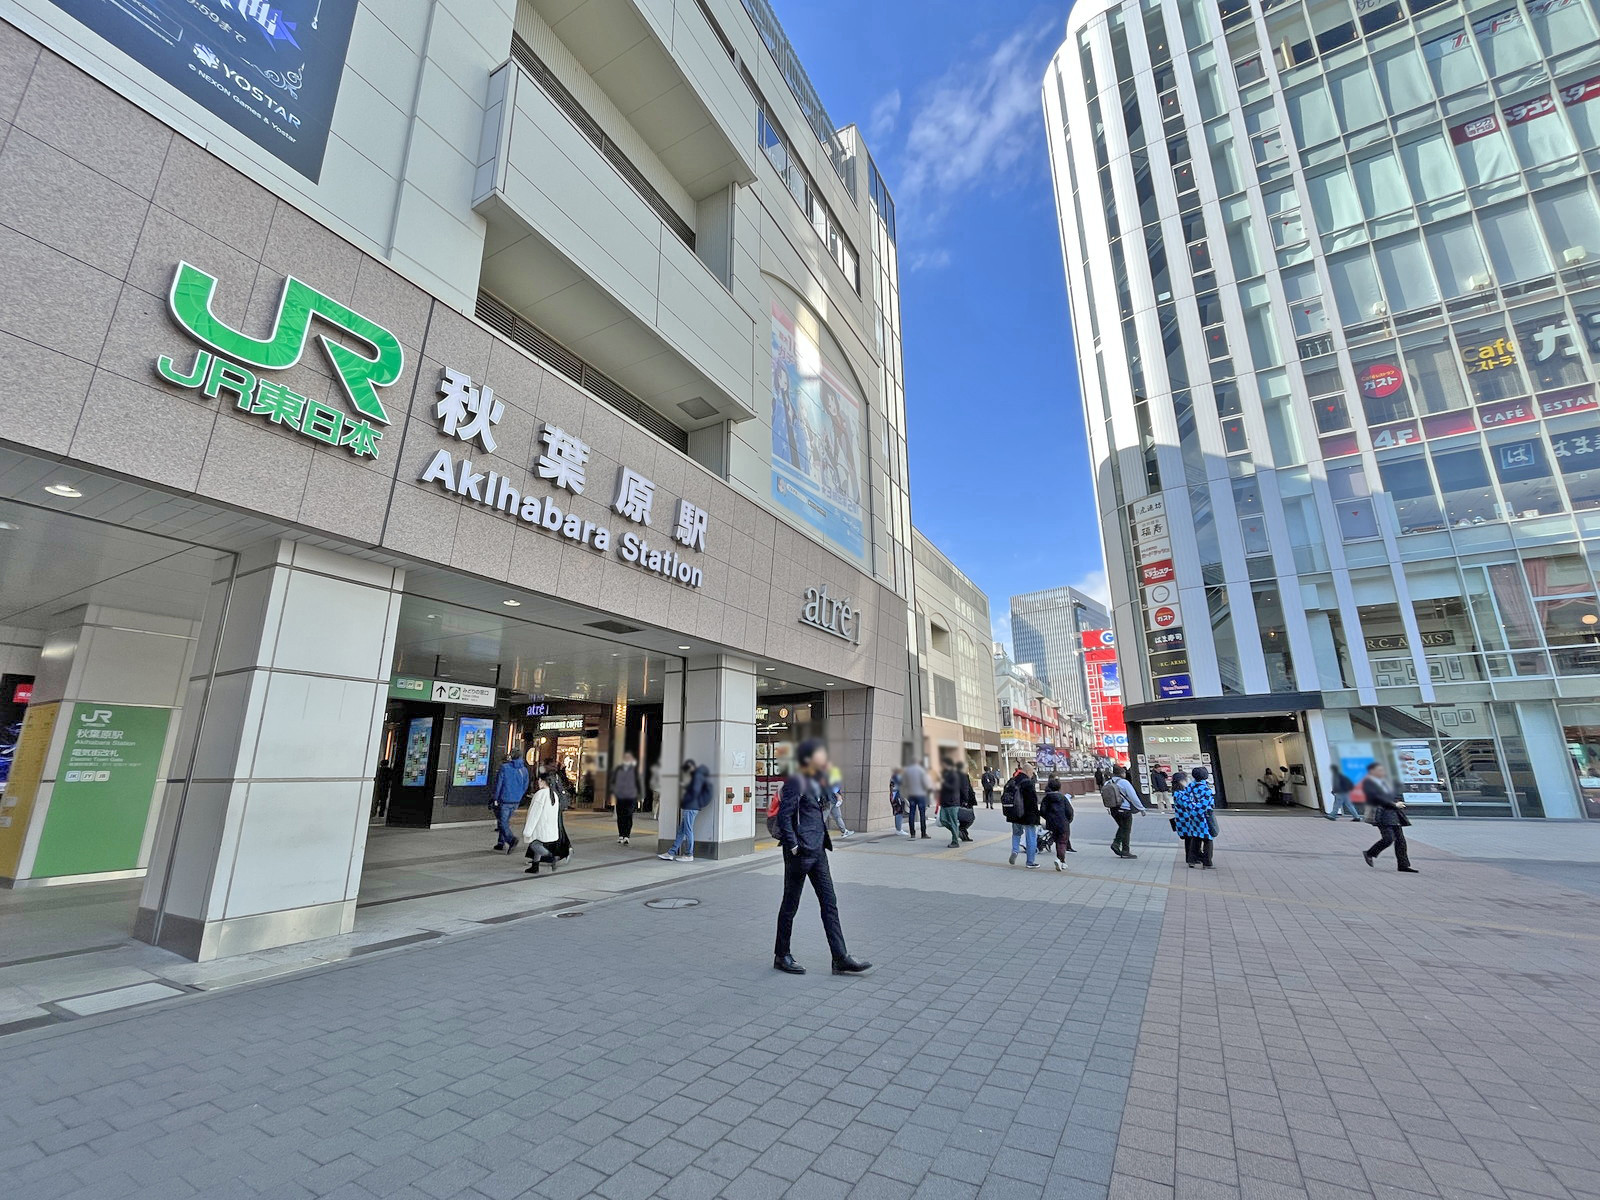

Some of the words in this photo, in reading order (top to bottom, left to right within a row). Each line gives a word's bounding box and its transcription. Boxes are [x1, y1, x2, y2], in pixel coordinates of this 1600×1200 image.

[187, 0, 247, 43] :59まで
[222, 62, 301, 129] YOSTAR
[198, 69, 231, 97] NEXON
[232, 94, 262, 119] Games
[271, 121, 297, 143] Yostar
[167, 260, 403, 425] JR
[1363, 376, 1398, 391] ガスト
[155, 349, 384, 460] JR東日本
[1482, 404, 1525, 423] CAFÉ
[1373, 428, 1414, 448] 4F
[434, 366, 708, 553] 秋葉原駅
[1507, 447, 1529, 463] は
[419, 449, 611, 552] Akihabara
[616, 530, 705, 588] Station
[801, 583, 854, 637] atré
[1157, 614, 1173, 622] ガスト
[1155, 633, 1182, 644] はま寿司
[1398, 634, 1444, 648] AMS
[81, 709, 112, 724] JR
[527, 703, 545, 716] atré
